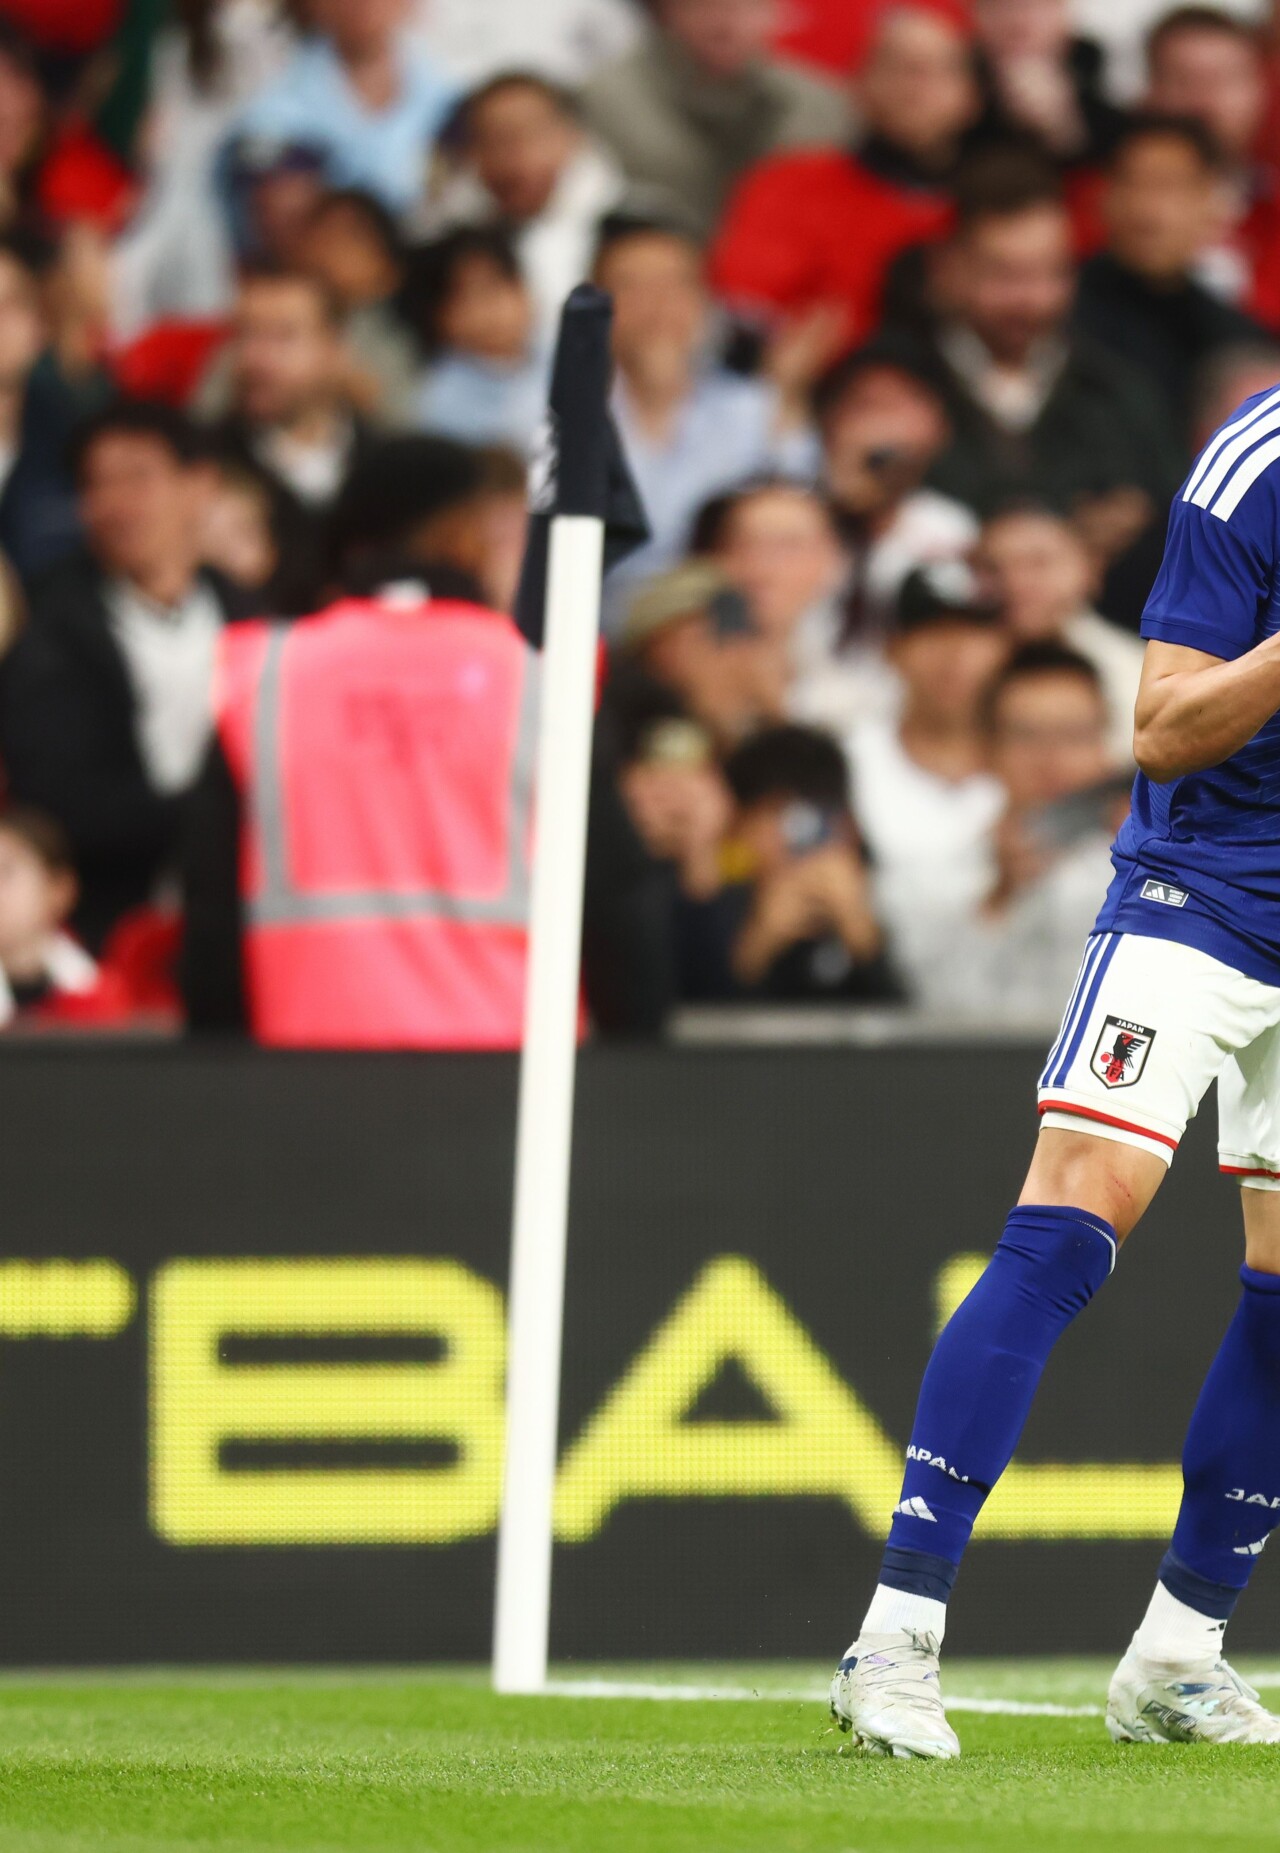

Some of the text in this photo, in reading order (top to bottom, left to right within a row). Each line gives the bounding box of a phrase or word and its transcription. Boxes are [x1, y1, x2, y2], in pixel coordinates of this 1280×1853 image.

[1116, 1020, 1145, 1034] JAPAN
[1101, 1065, 1125, 1081] JFA
[906, 1444, 969, 1482] APA
